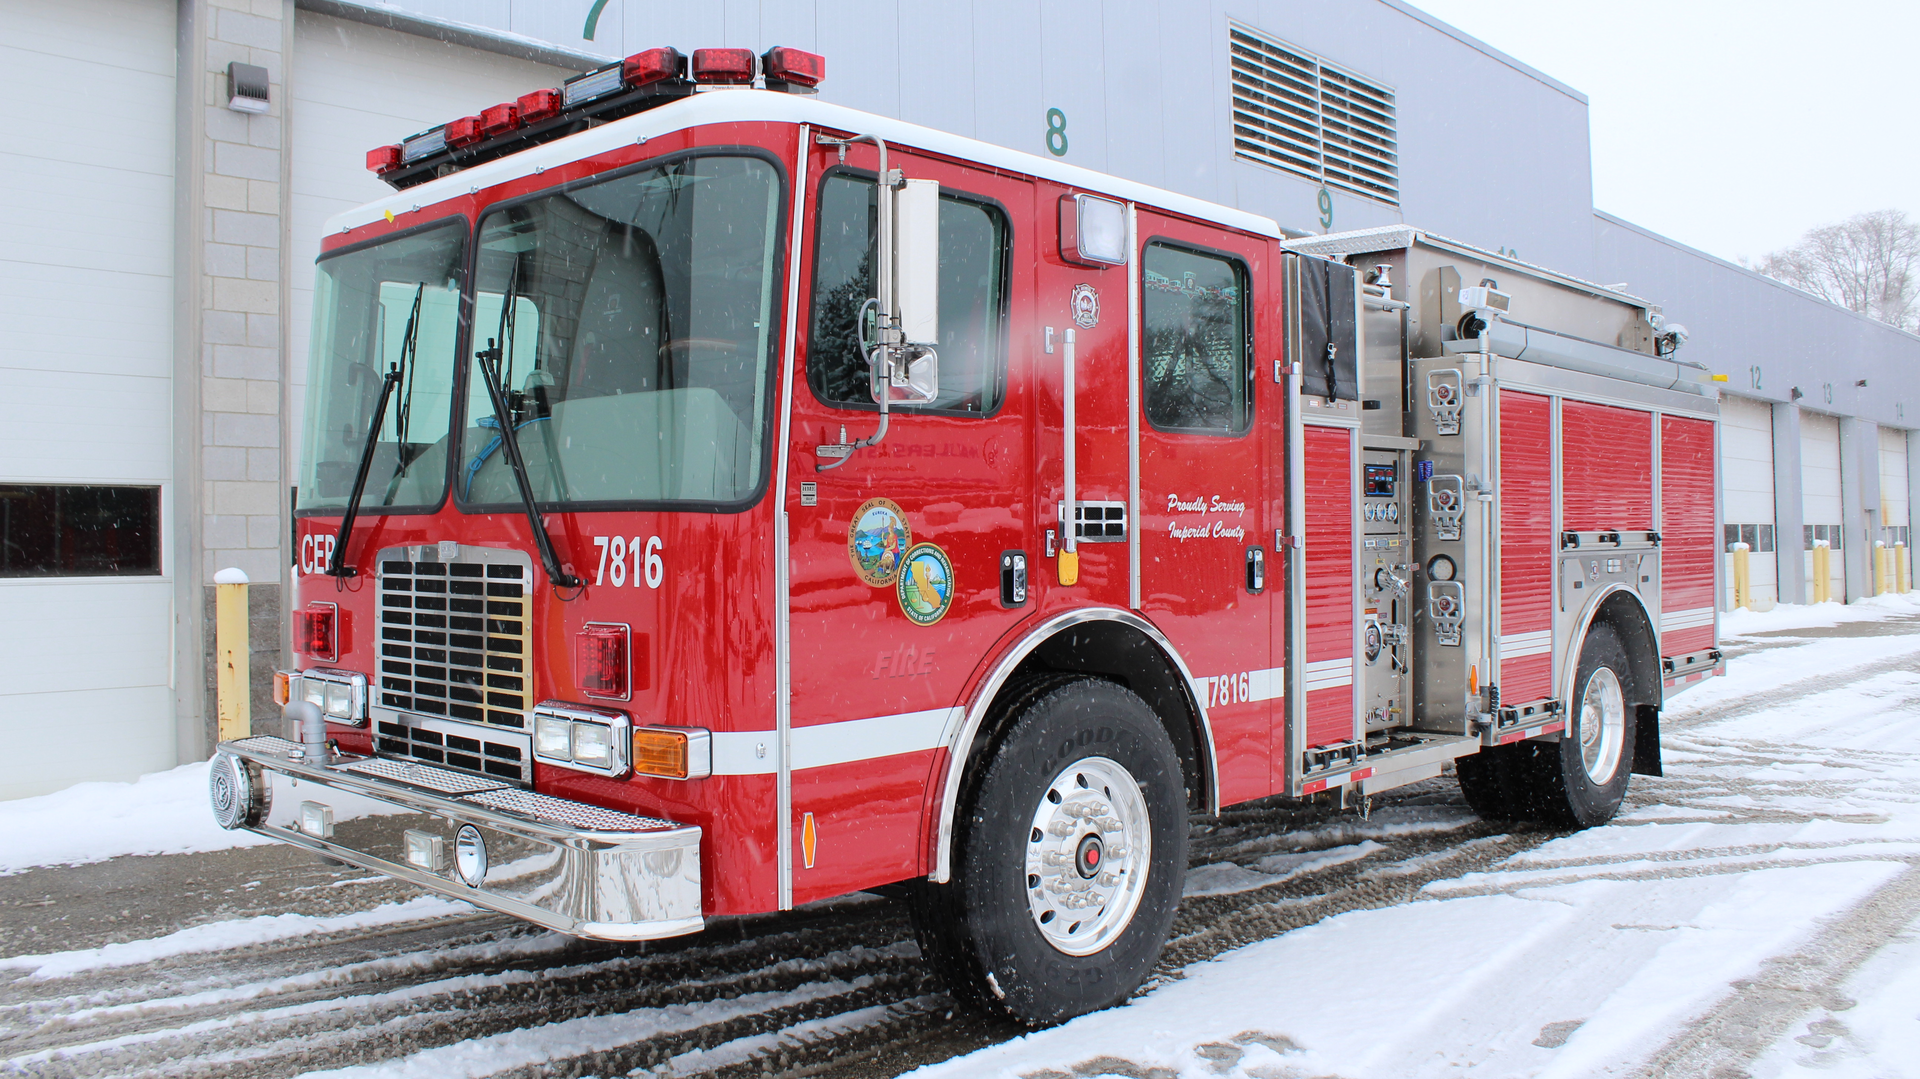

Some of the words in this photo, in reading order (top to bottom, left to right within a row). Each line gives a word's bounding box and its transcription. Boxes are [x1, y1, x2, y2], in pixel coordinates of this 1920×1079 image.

[1046, 107, 1068, 157] 8
[1317, 189, 1332, 229] 9
[1750, 365, 1762, 390] 12
[1822, 382, 1833, 405] 13
[849, 516, 860, 539] GREAT
[861, 502, 874, 512] SEAL
[890, 503, 900, 514] THE
[901, 517, 911, 539] STATE
[1167, 493, 1208, 517] Proudly
[1210, 494, 1245, 518] Serving
[1168, 521, 1211, 544] Imperial
[1212, 520, 1245, 543] County
[593, 535, 664, 589] 7816
[900, 565, 908, 600] DEPARTMENT
[909, 547, 935, 560] CORRECTIONS
[934, 550, 942, 560] AND
[864, 574, 897, 585] CALIFORNIA
[906, 606, 918, 619] STATE
[923, 604, 945, 622] CALIFORNIA
[872, 647, 937, 680] FIRE
[1209, 671, 1249, 708] 7816
